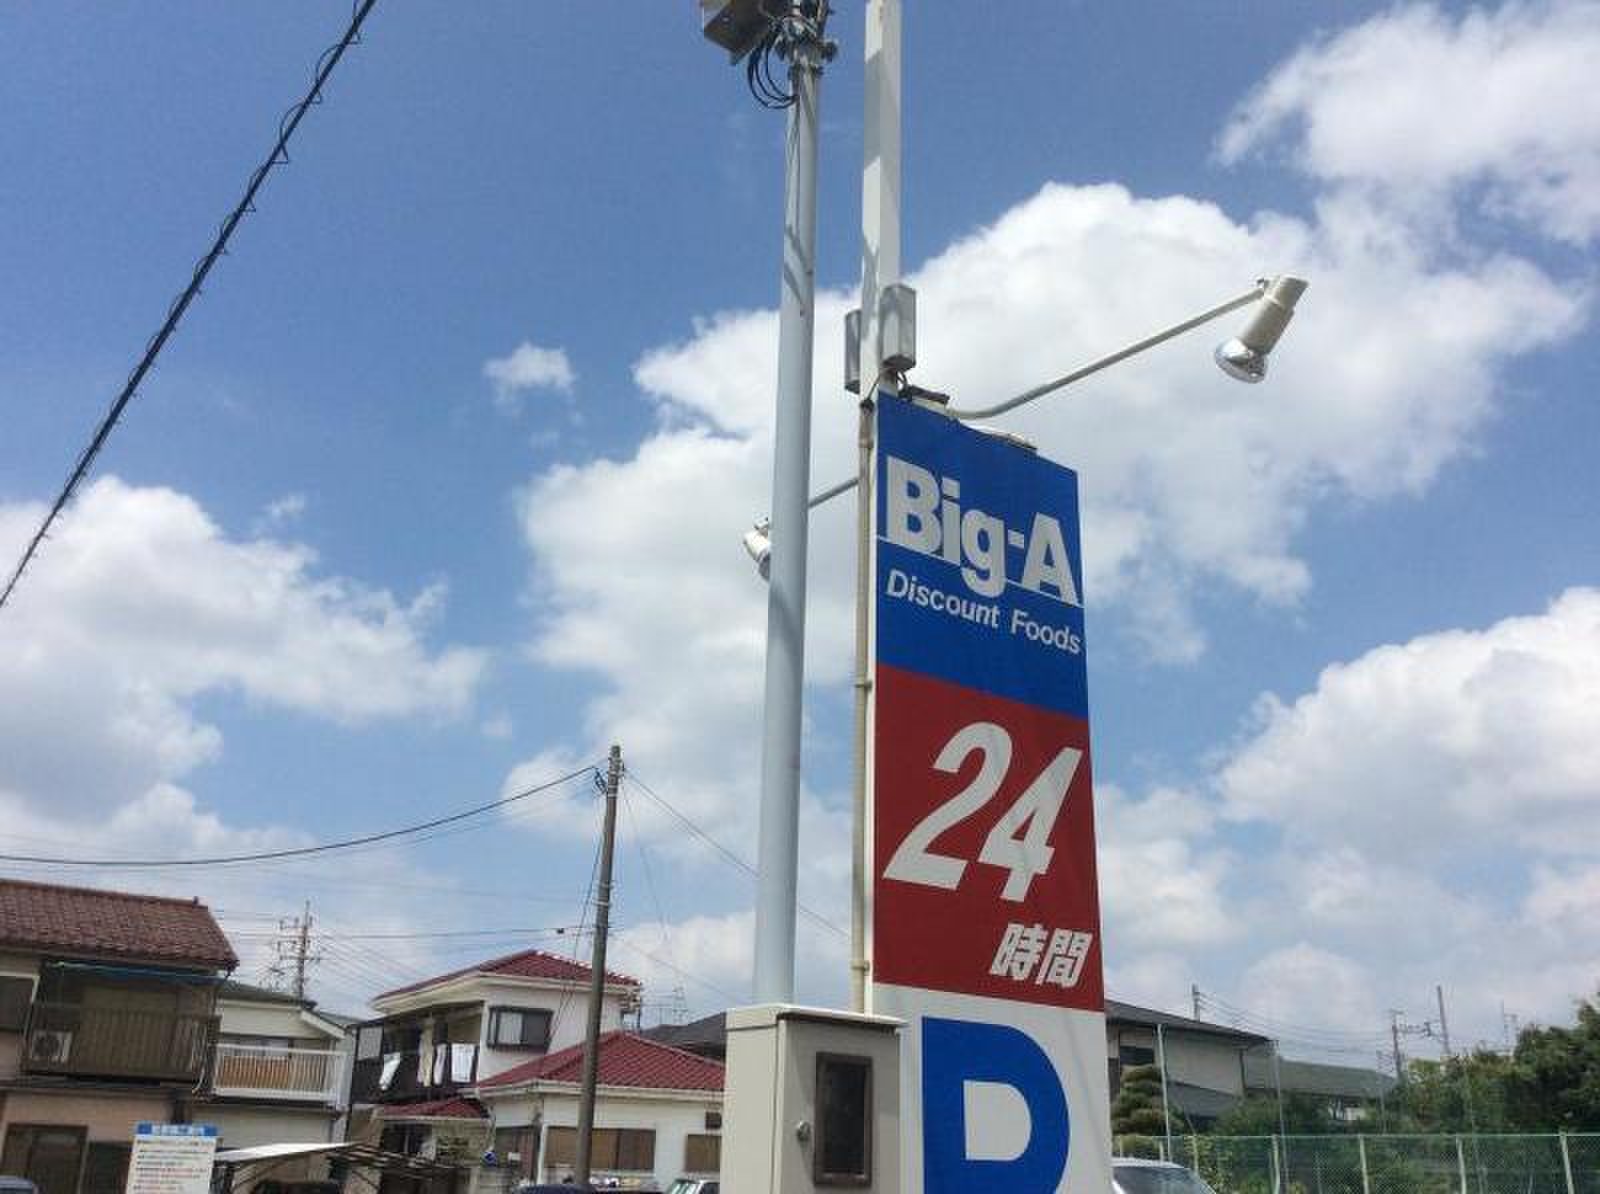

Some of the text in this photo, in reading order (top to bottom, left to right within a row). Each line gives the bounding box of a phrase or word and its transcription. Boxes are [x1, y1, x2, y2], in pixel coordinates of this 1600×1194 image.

[887, 456, 1079, 606] Big-A
[886, 569, 1082, 655] Discount Foods
[882, 721, 1083, 903] 24
[989, 922, 1093, 989] 時間
